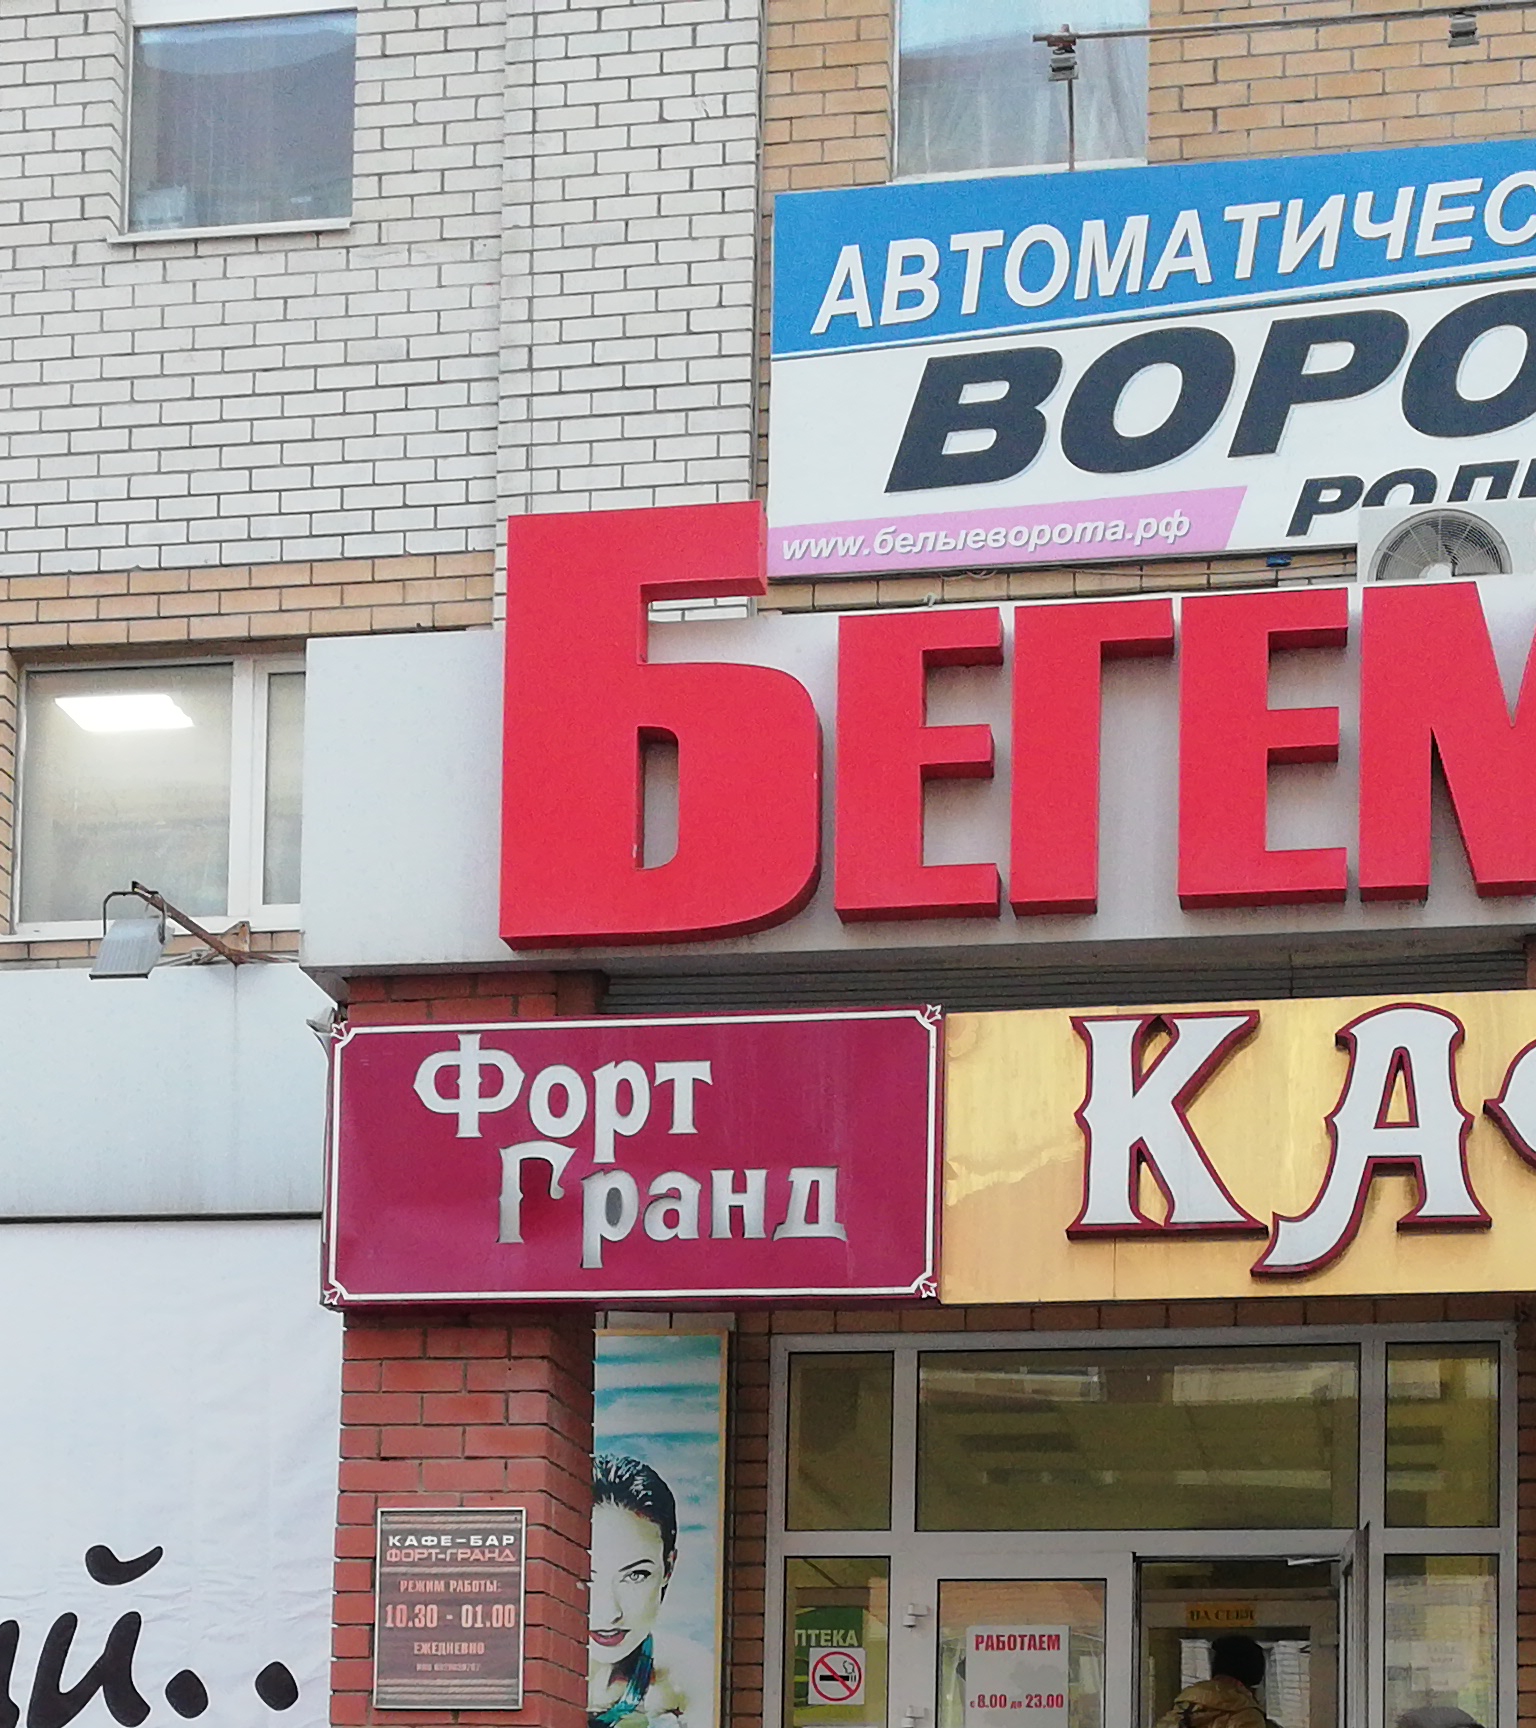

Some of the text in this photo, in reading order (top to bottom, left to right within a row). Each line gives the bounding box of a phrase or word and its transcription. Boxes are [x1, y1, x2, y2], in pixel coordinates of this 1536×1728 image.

[781, 508, 1192, 561] www.белыеворота.рф
[412, 1032, 714, 1165] Форт
[496, 1140, 848, 1269] Гранд
[388, 1535, 516, 1547] КАФЕ-БАР
[386, 1548, 516, 1563] ФОРТ-ГРАНД
[399, 1580, 445, 1593] РЕЖИМ
[384, 1604, 438, 1629] 10.30
[461, 1604, 516, 1628] 01.00
[413, 1641, 485, 1656] ЕЖЕДНЕВНО
[974, 1633, 1061, 1651] РАБОТАЕМ
[977, 1693, 1008, 1709] 8.00
[1025, 1693, 1065, 1709] 23.00
